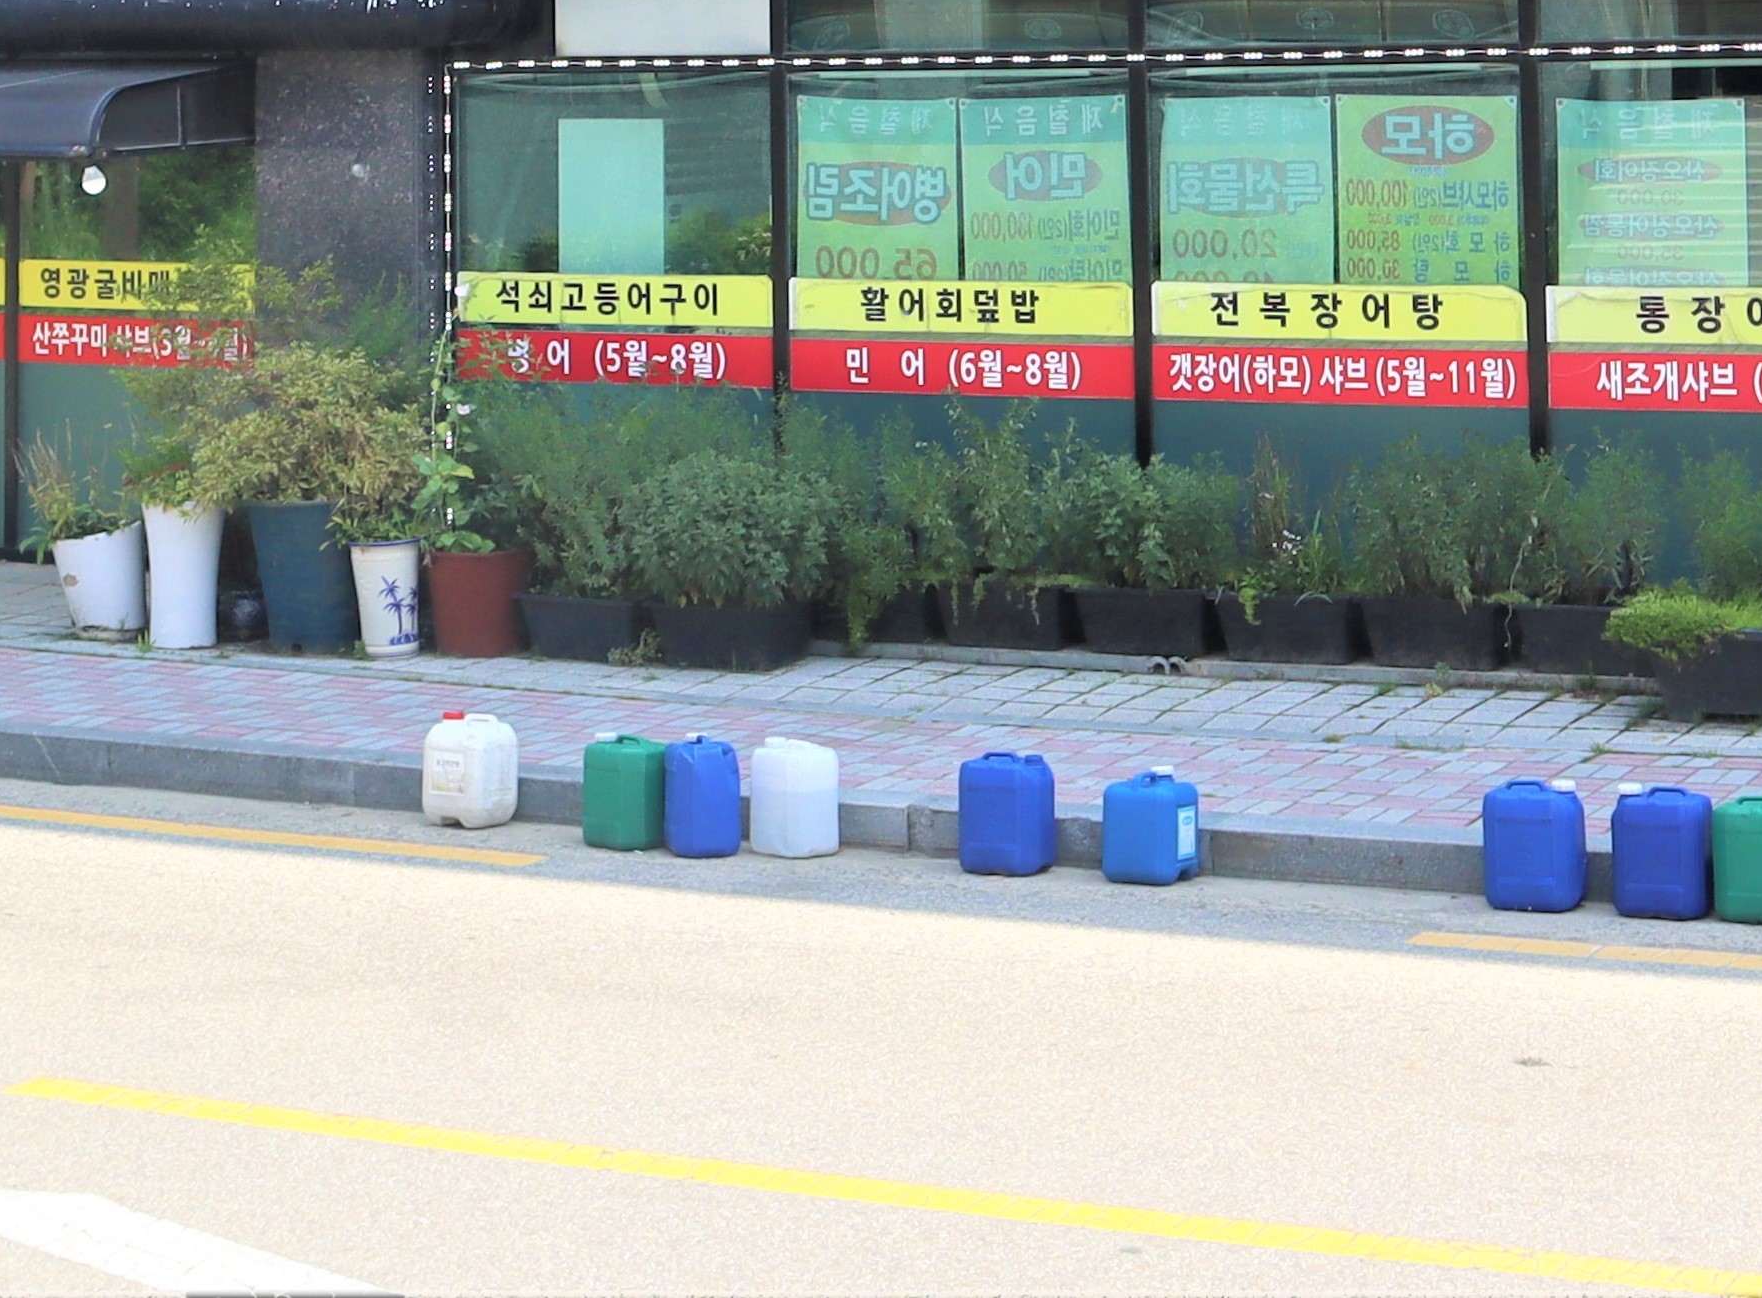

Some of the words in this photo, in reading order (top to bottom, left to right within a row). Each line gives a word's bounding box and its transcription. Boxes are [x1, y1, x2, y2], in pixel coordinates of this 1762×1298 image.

[494, 279, 720, 317] 석쇠고등어구이
[858, 286, 1040, 324] 활어회덮밥
[1209, 291, 1445, 331] 전복장어탕
[32, 321, 108, 358] 산쭈꾸미
[594, 339, 727, 380] (5월~8월)
[947, 347, 1083, 392] (6월~8월)
[1169, 354, 1311, 396] 갯장어(하모)
[1318, 356, 1369, 396] 샤브
[1375, 356, 1517, 402] (5월~11월)
[1595, 359, 1738, 401] 새조개샤브
